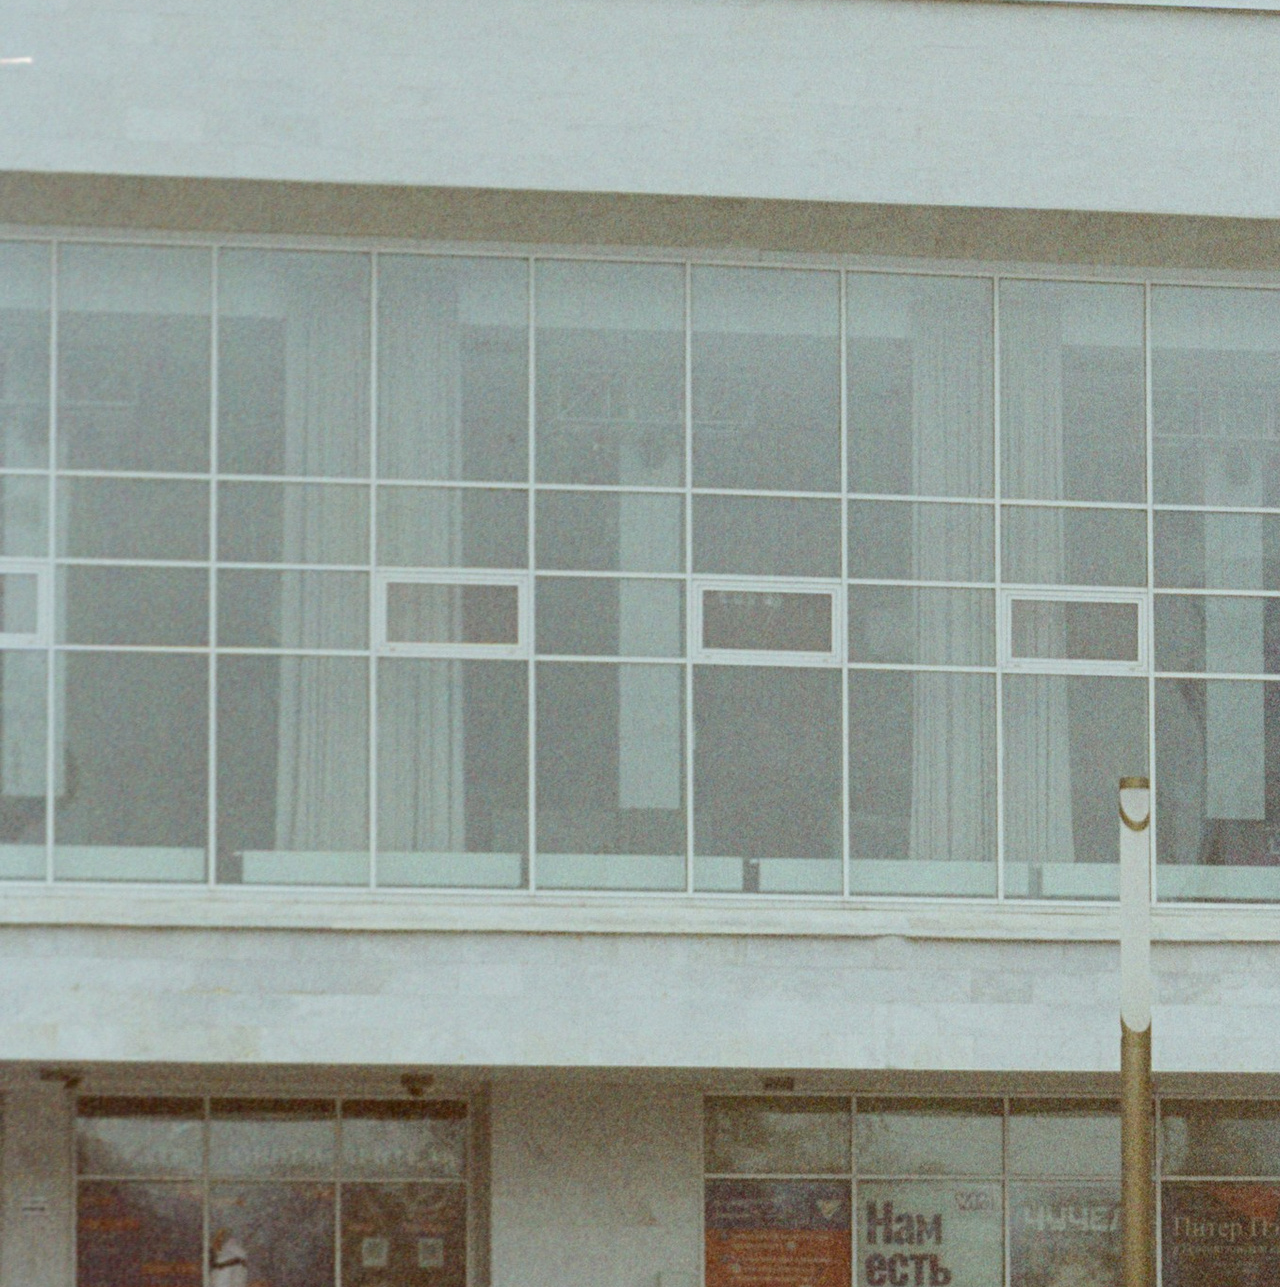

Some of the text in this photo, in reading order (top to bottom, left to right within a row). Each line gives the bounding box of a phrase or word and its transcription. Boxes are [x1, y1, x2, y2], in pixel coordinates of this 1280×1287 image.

[866, 1201, 941, 1244] Нам
[1172, 1216, 1242, 1242] Питер
[866, 1254, 951, 1286] есть
